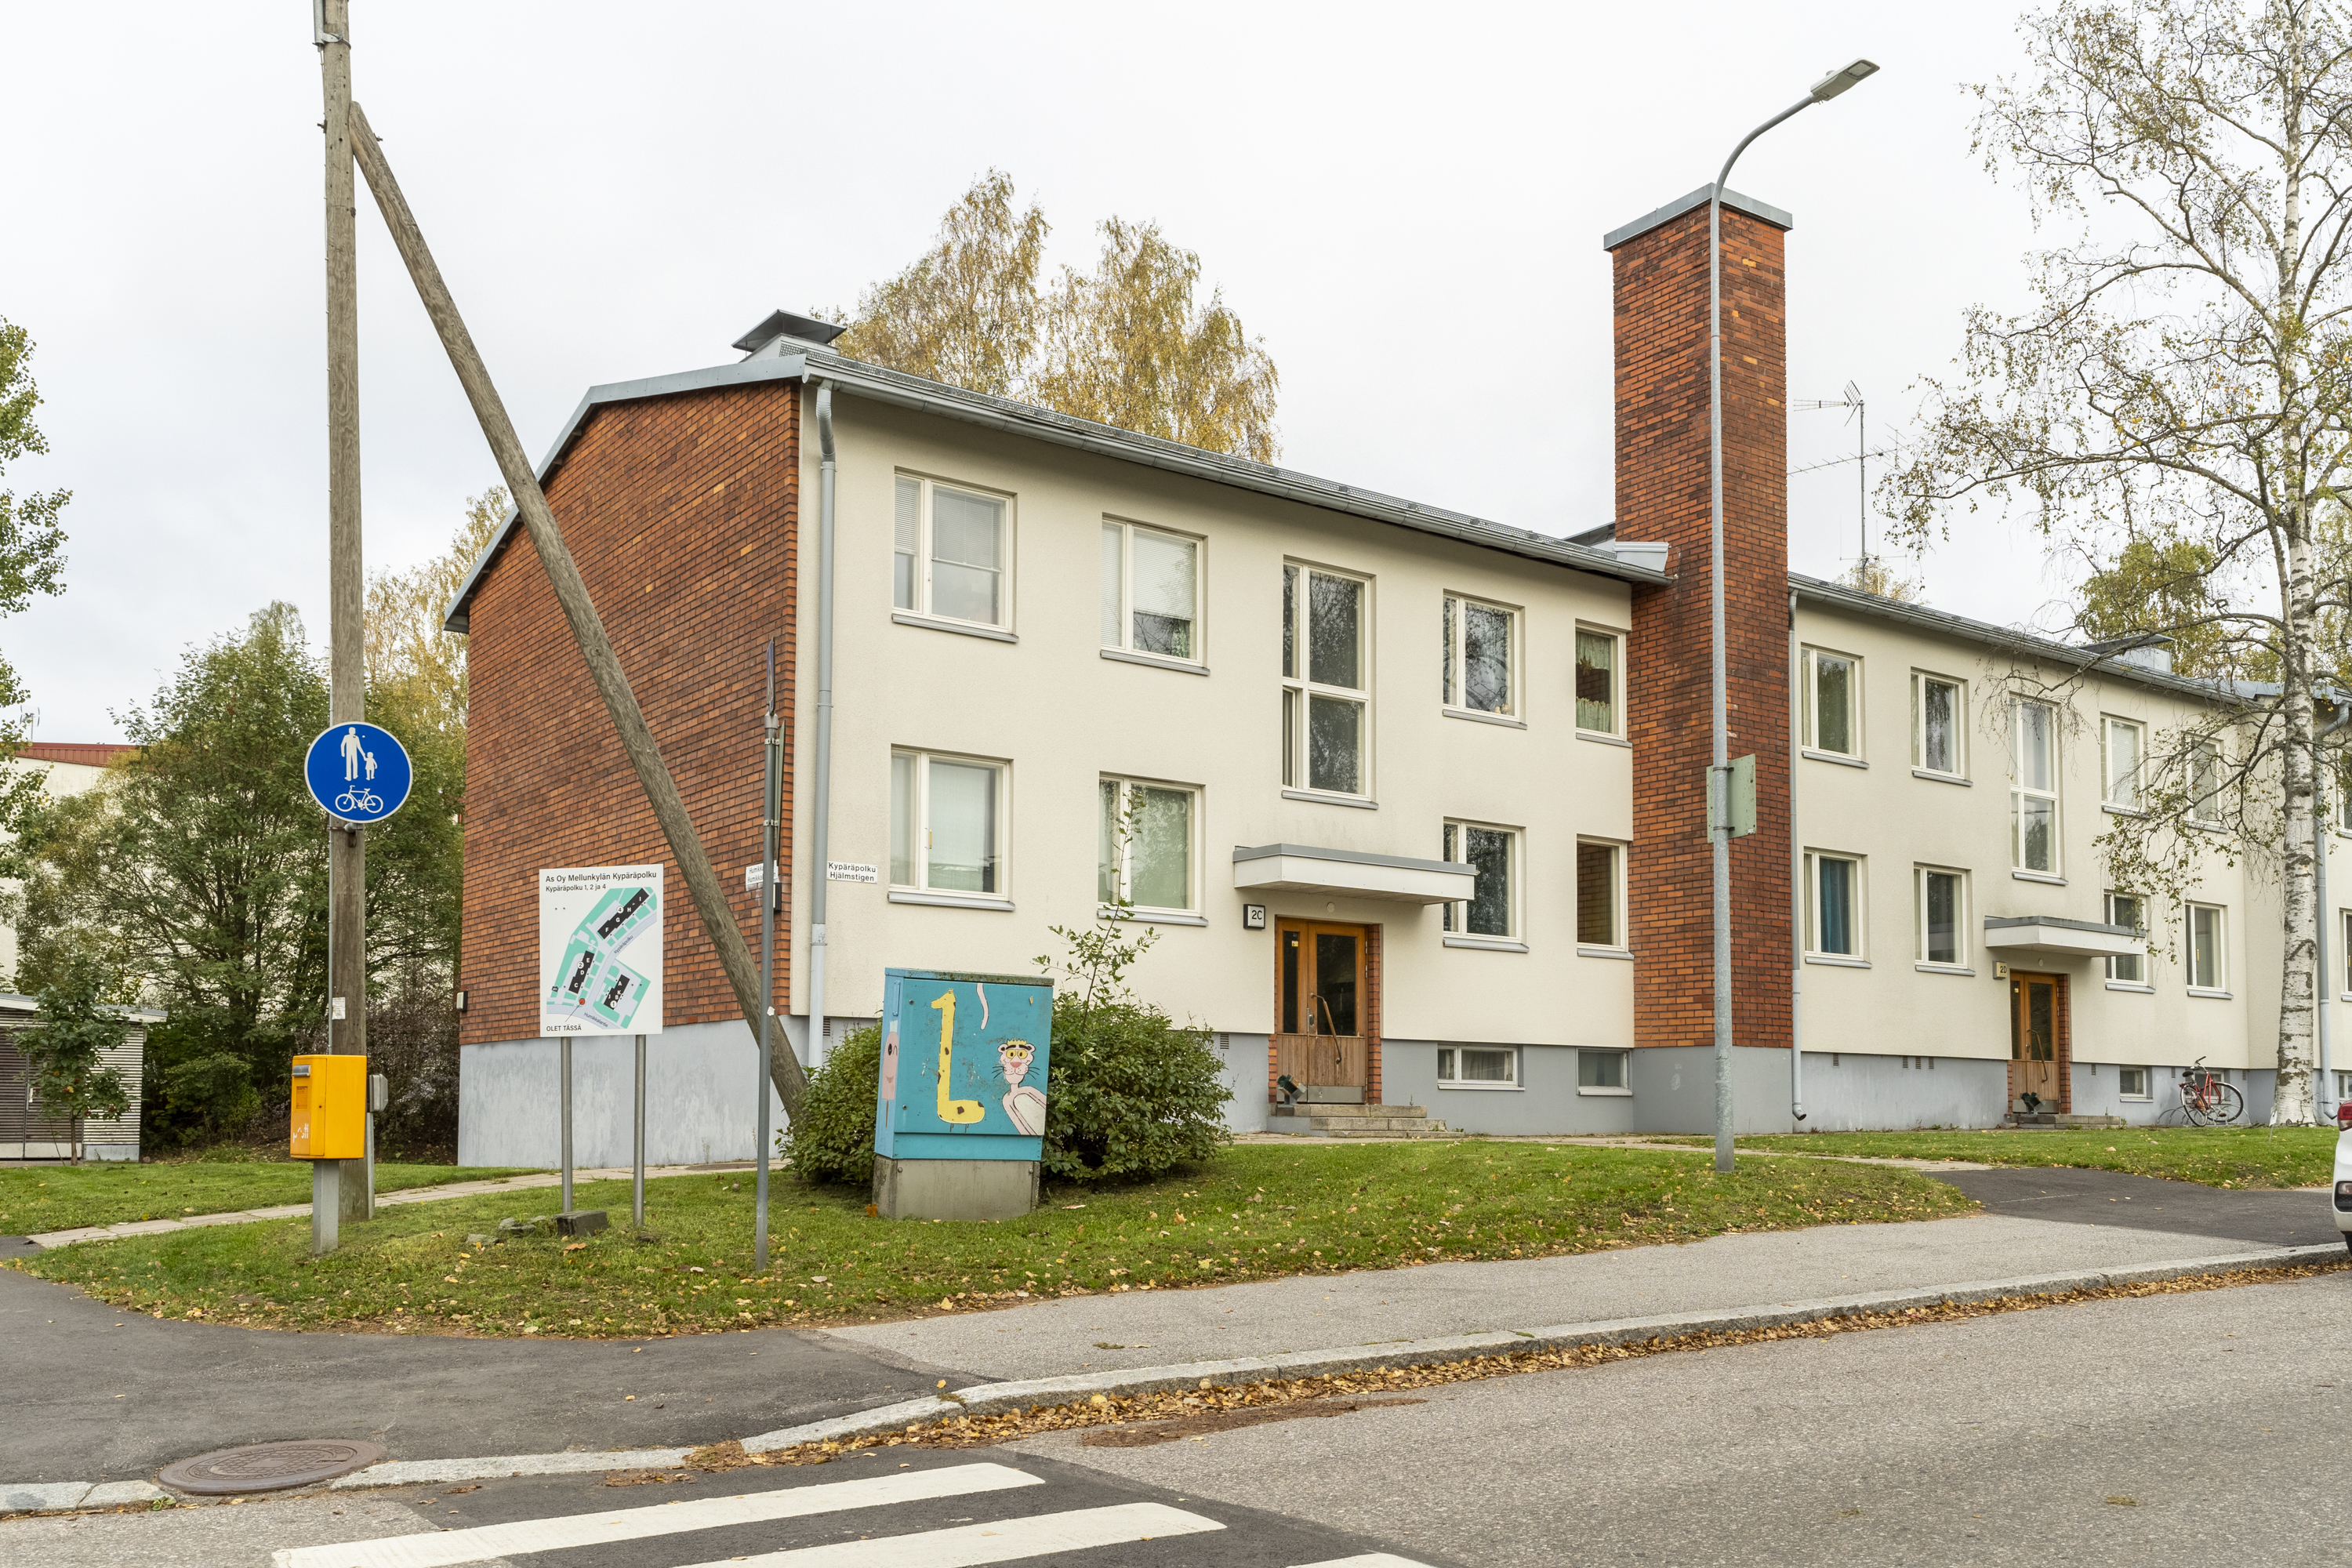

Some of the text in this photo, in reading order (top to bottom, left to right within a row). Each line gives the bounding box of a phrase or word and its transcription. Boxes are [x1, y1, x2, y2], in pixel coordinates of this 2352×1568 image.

[829, 862, 876, 873] Kypäräpolku
[557, 874, 565, 883] Oy
[568, 873, 611, 882] Mellunkylän
[612, 871, 657, 881] Kypäräpolku
[830, 871, 874, 882] Hjälmstigen
[546, 884, 583, 893] Kypäräpolku
[1251, 909, 1263, 920] 2C
[614, 935, 633, 954] Kypäräpolku
[2000, 965, 2007, 974] 2D
